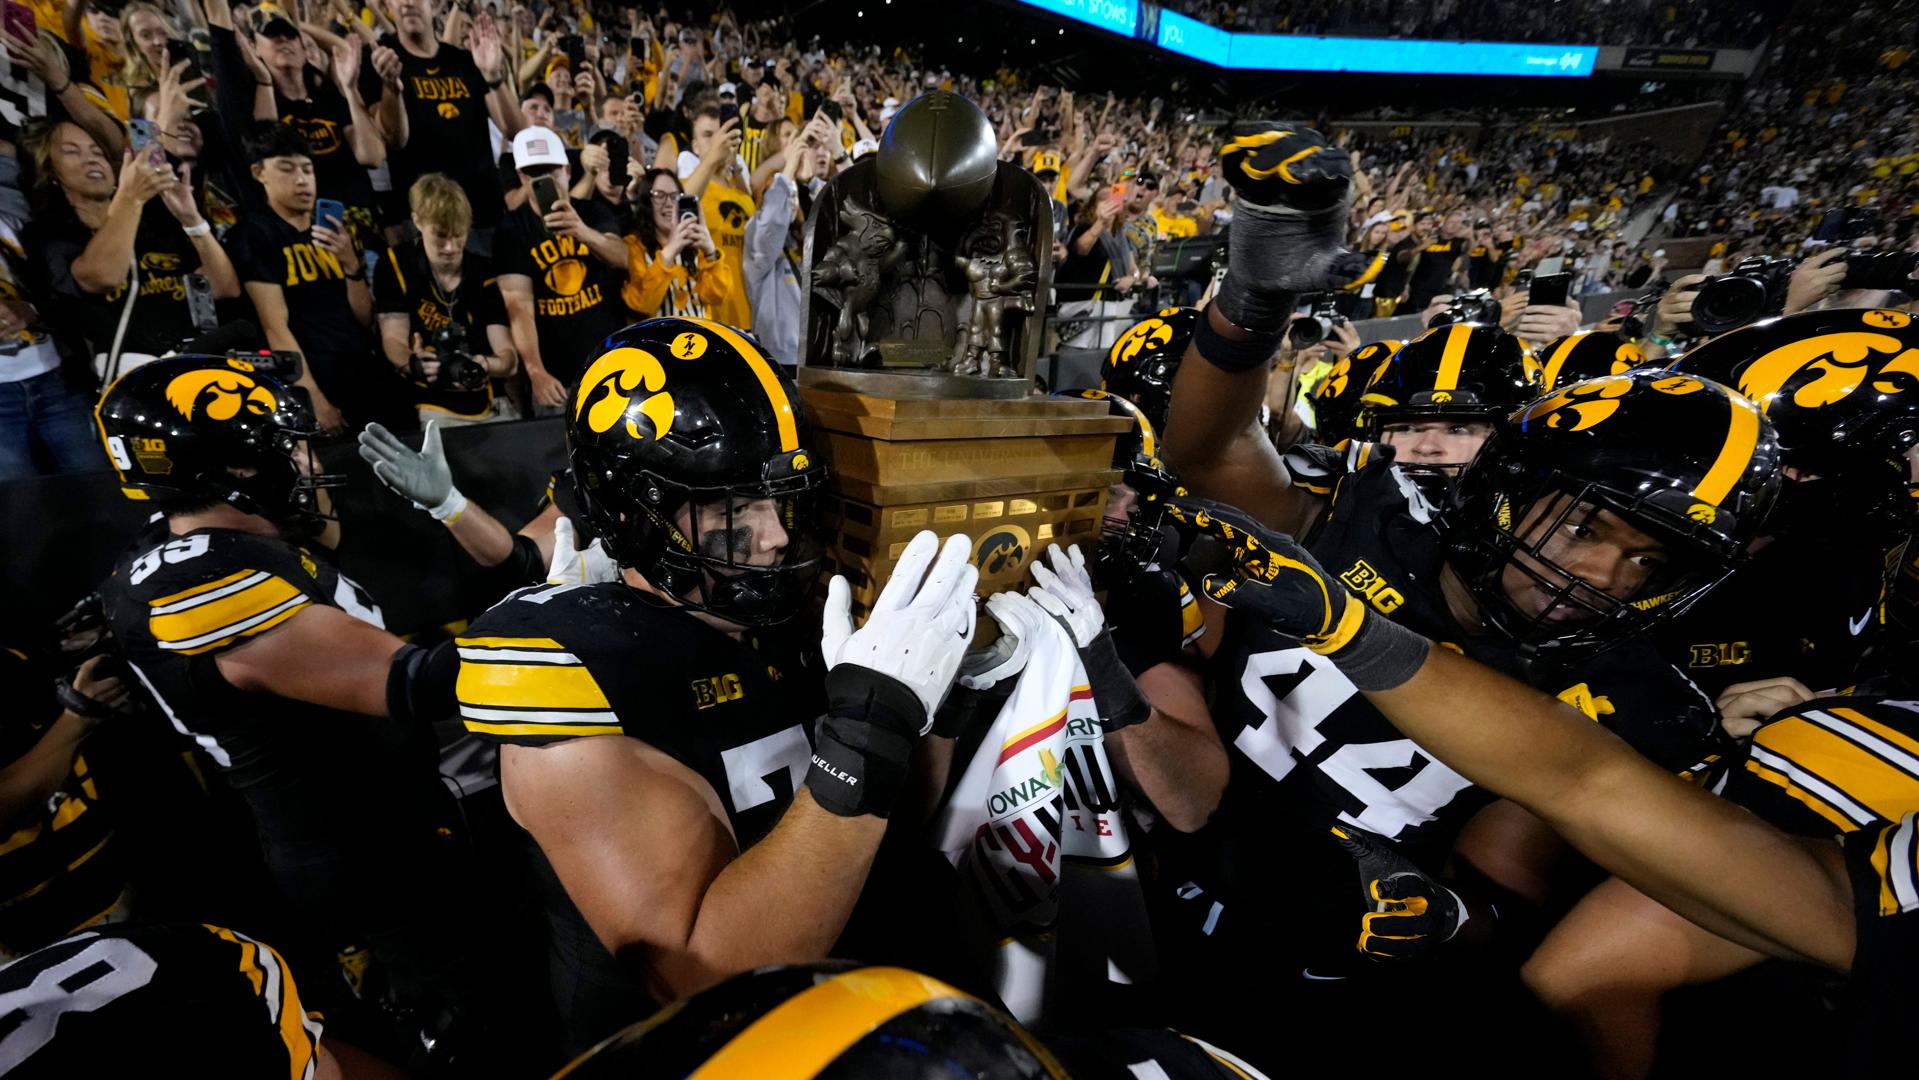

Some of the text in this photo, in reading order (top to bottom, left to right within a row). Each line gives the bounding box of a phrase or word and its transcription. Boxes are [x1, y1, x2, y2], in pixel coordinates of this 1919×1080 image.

[412, 76, 471, 100] IOWA
[282, 243, 346, 287] IOW
[537, 283, 603, 316] FOOTBALL
